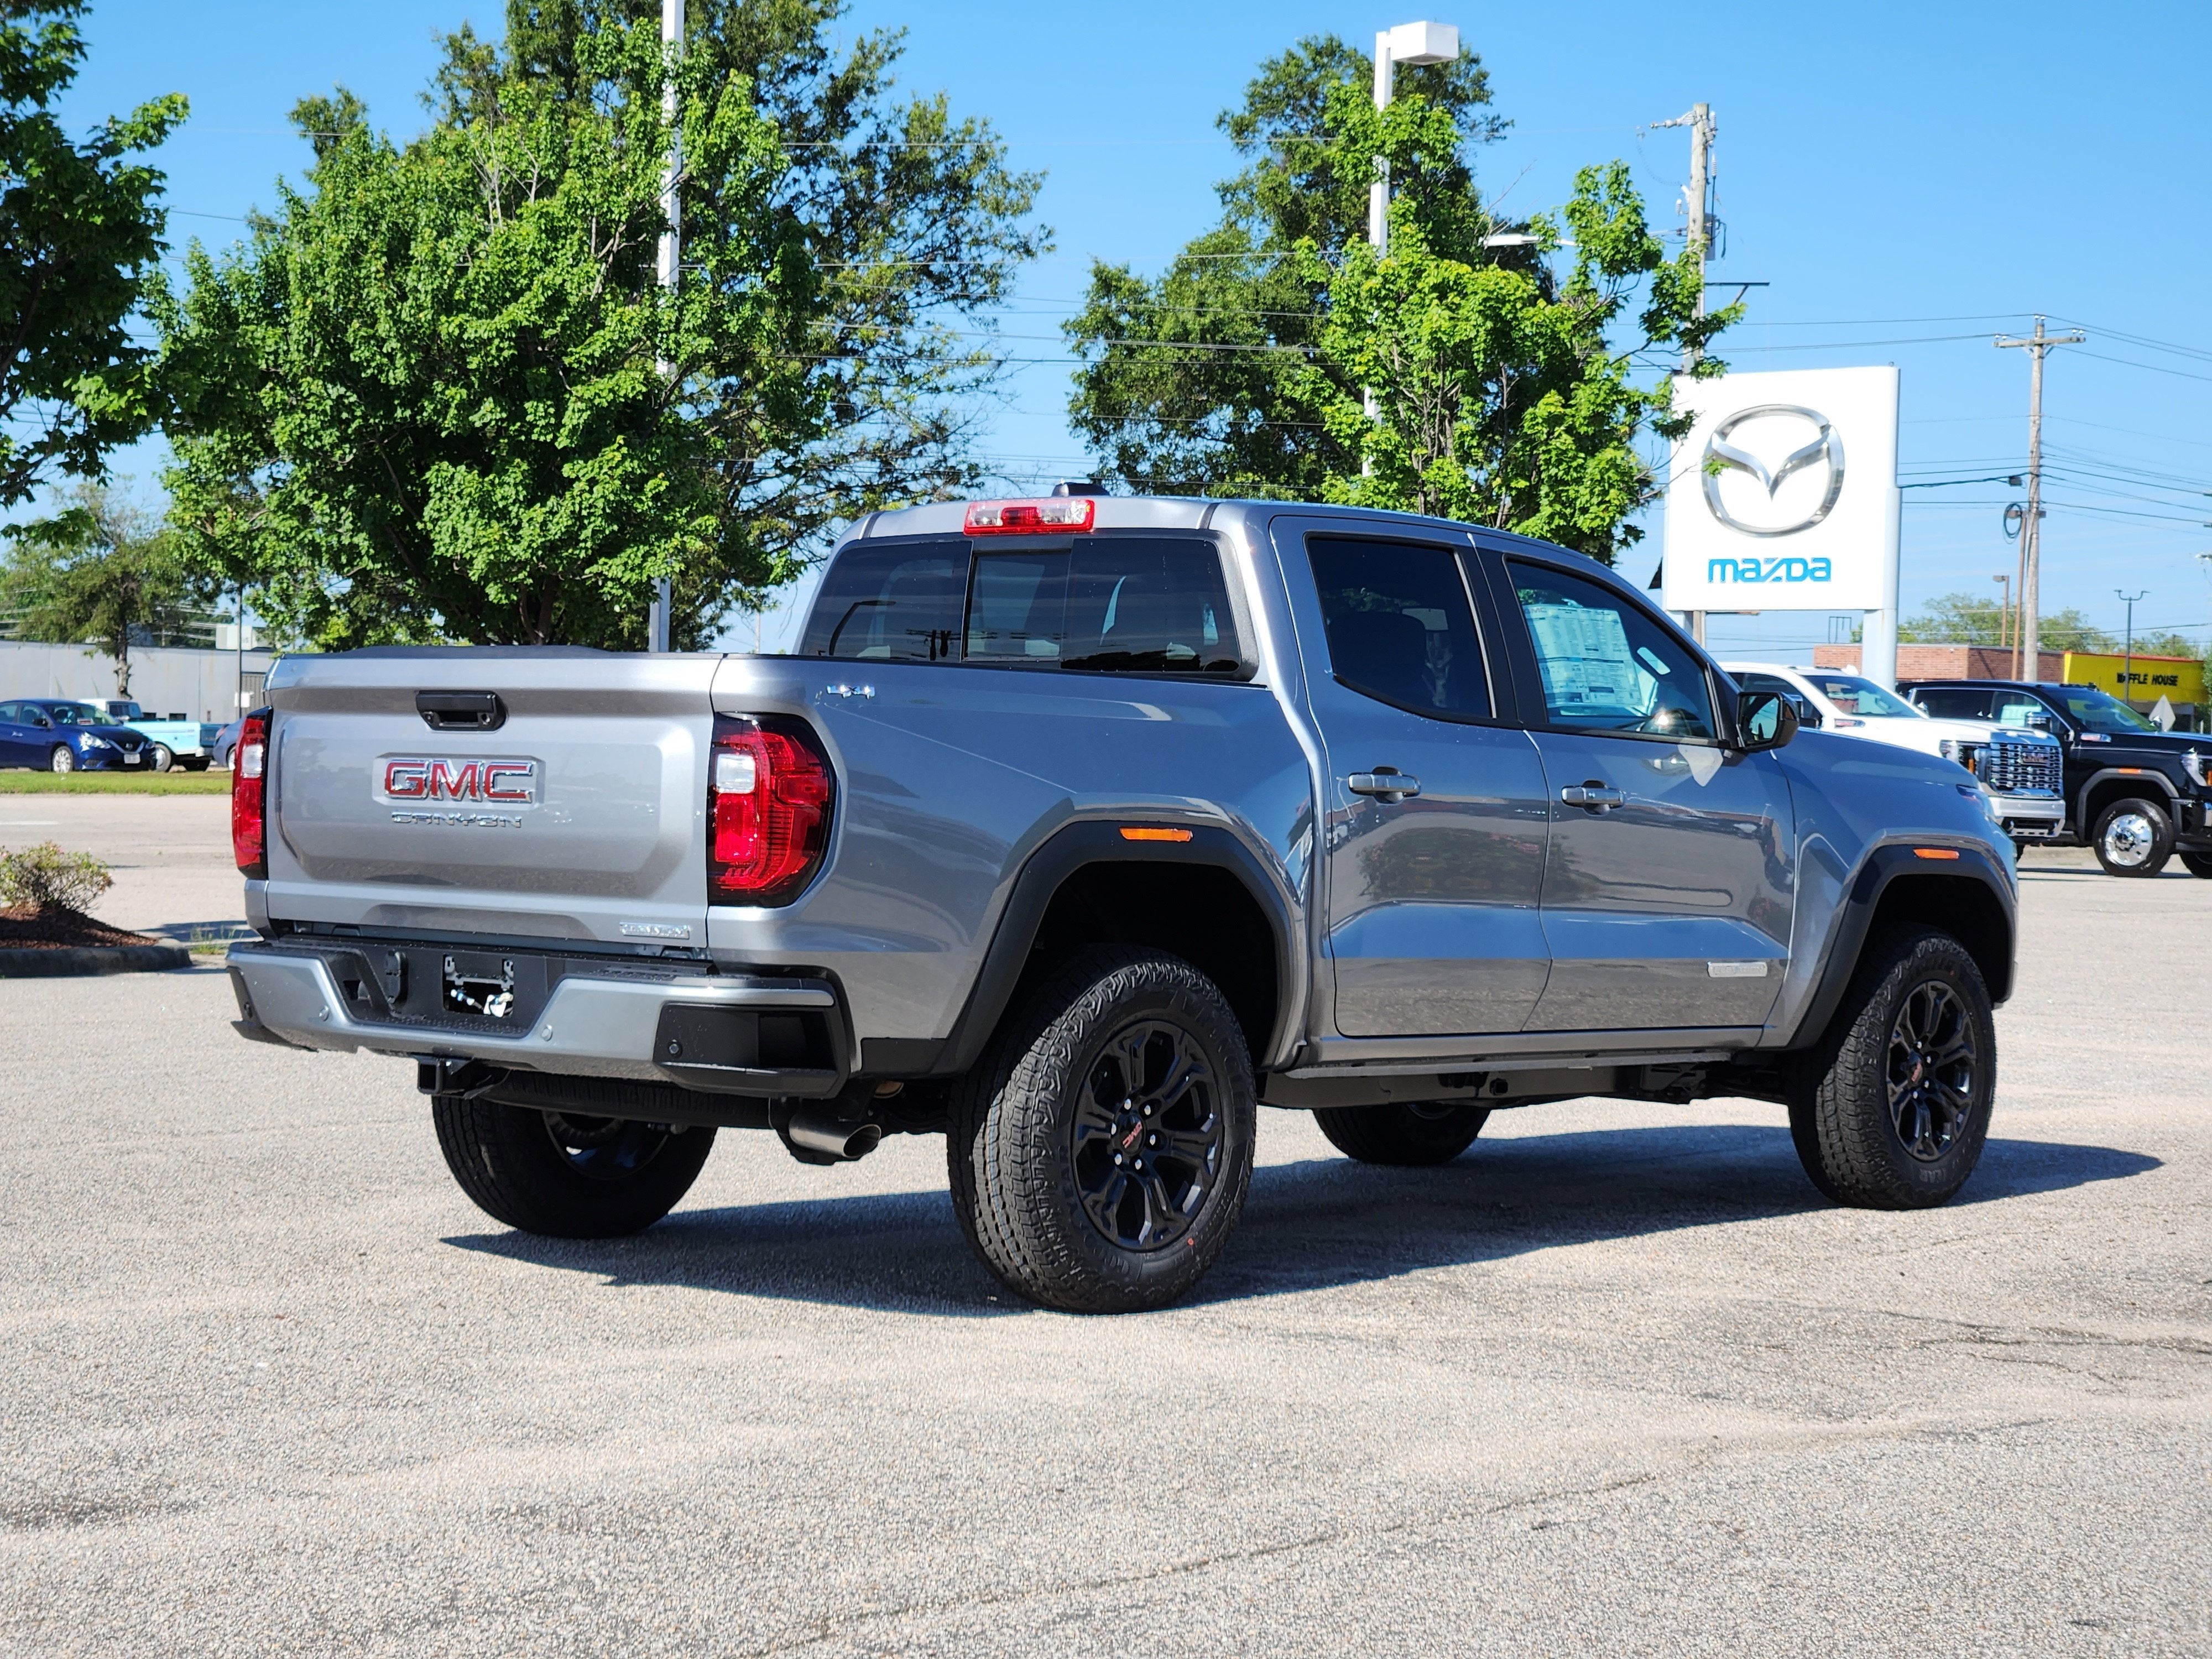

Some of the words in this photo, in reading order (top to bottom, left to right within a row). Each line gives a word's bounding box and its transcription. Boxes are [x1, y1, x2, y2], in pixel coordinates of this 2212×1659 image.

[2117, 673, 2148, 685] WFFLE
[2151, 674, 2178, 686] HOUSE
[385, 759, 536, 803] GMC
[390, 811, 522, 828] CANYON
[1123, 1121, 1142, 1149] GMC
